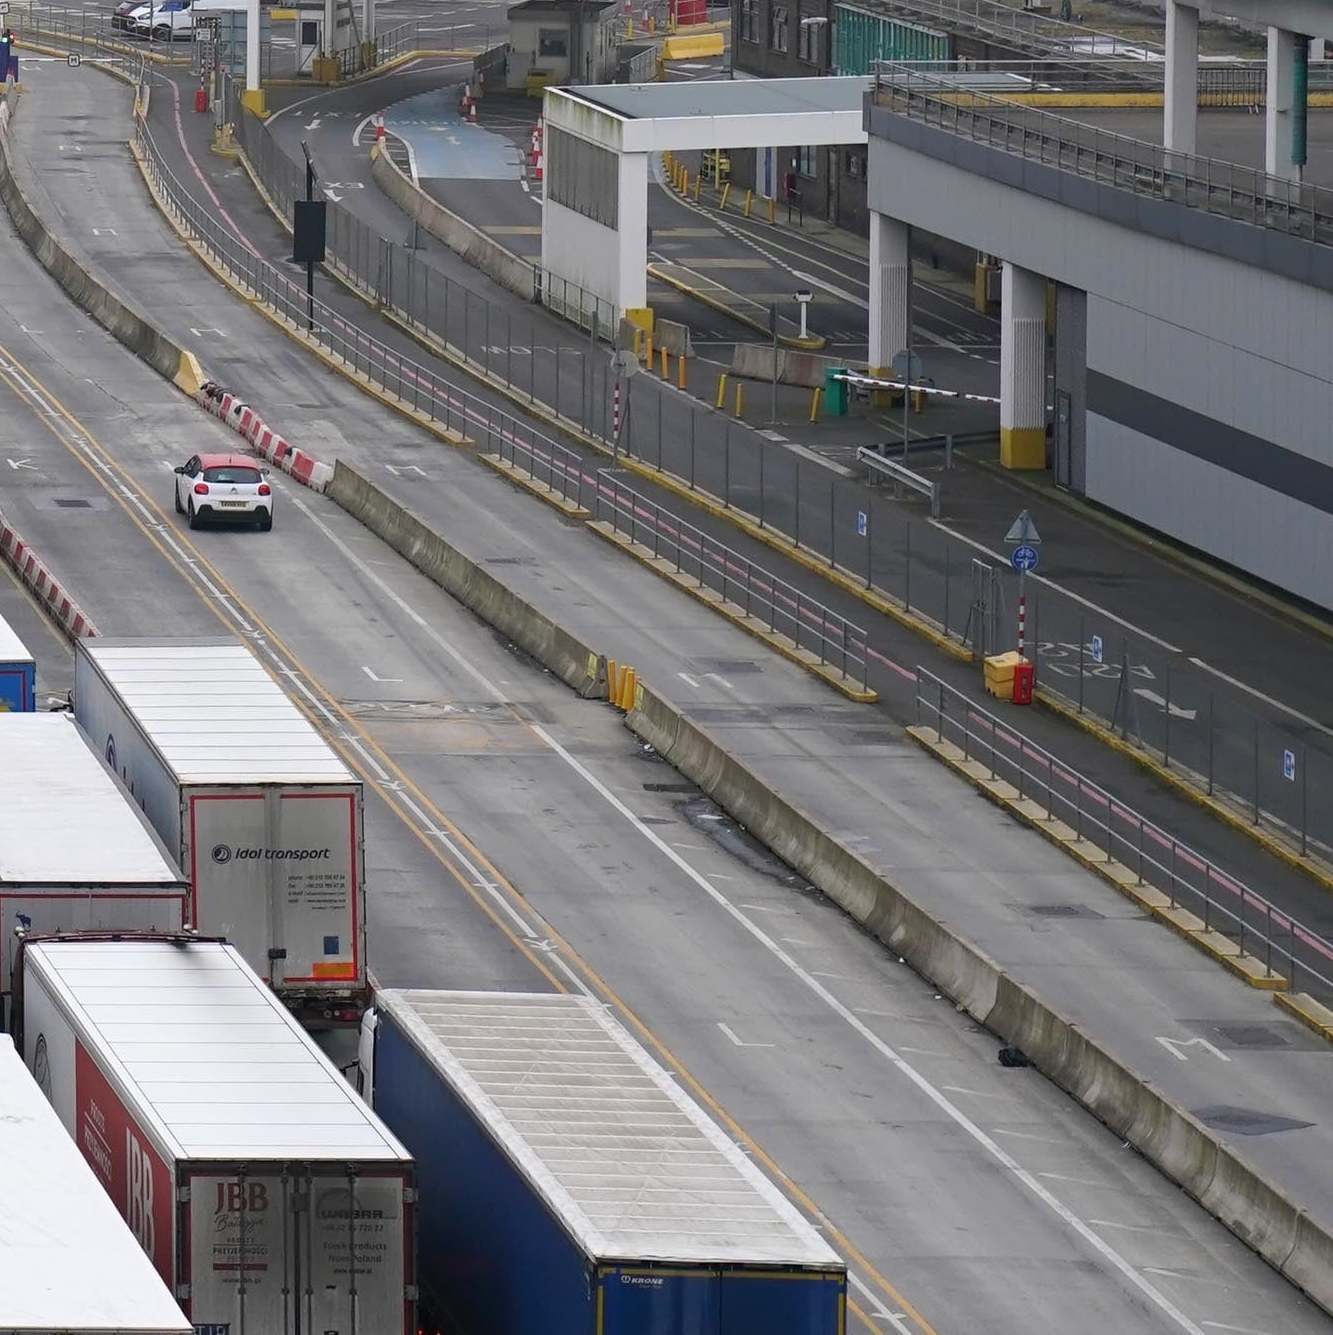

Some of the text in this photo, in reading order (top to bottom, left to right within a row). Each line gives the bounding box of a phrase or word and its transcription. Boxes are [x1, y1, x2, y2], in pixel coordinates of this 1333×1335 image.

[265, 848, 330, 861] transport
[215, 1182, 269, 1214] JBB
[631, 1277, 664, 1285] KRONE
